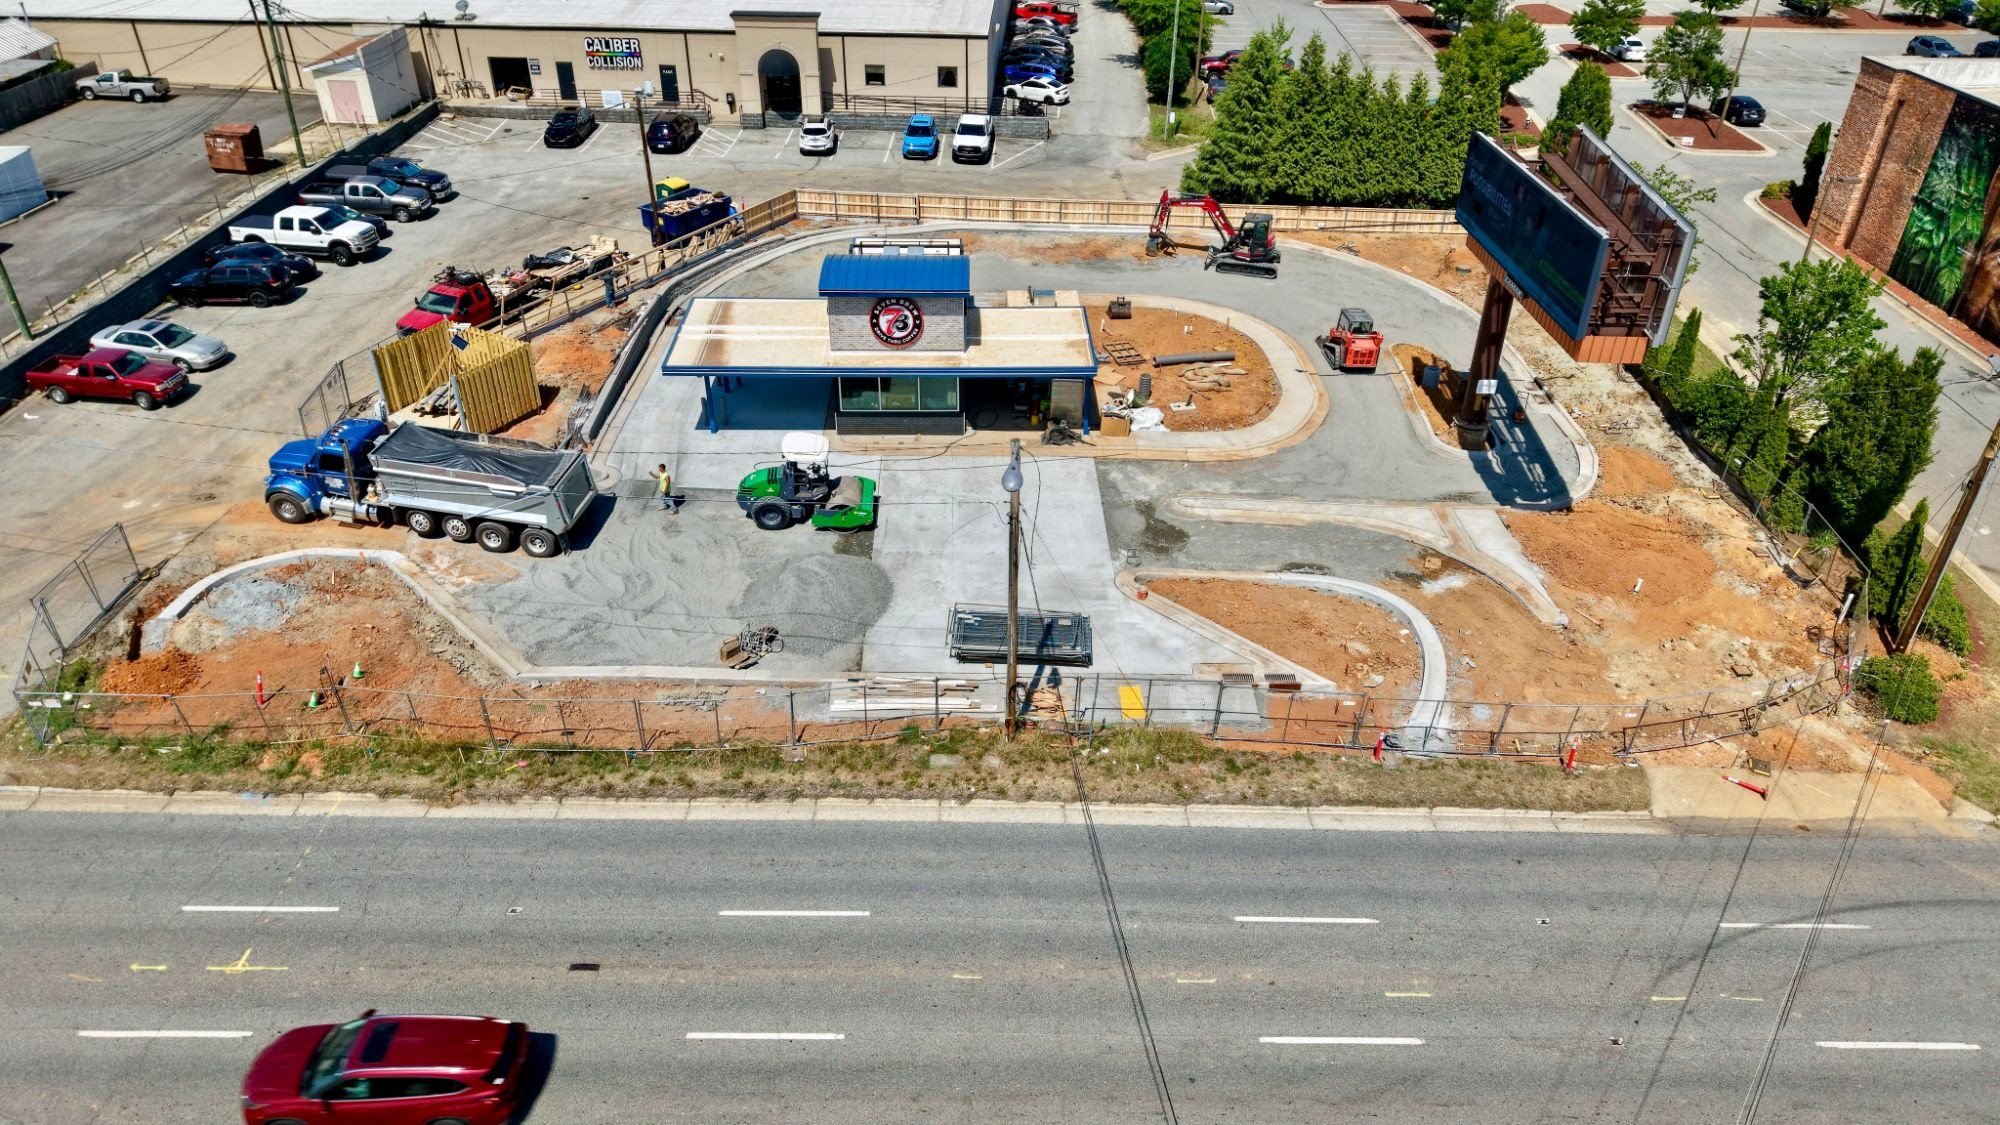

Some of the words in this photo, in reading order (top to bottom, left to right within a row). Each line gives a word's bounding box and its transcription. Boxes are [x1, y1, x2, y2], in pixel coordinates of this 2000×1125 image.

[584, 37, 640, 52] CALIBER
[586, 56, 642, 67] COLLISION
[874, 298, 896, 315] SEVEN
[899, 299, 919, 316] BREW
